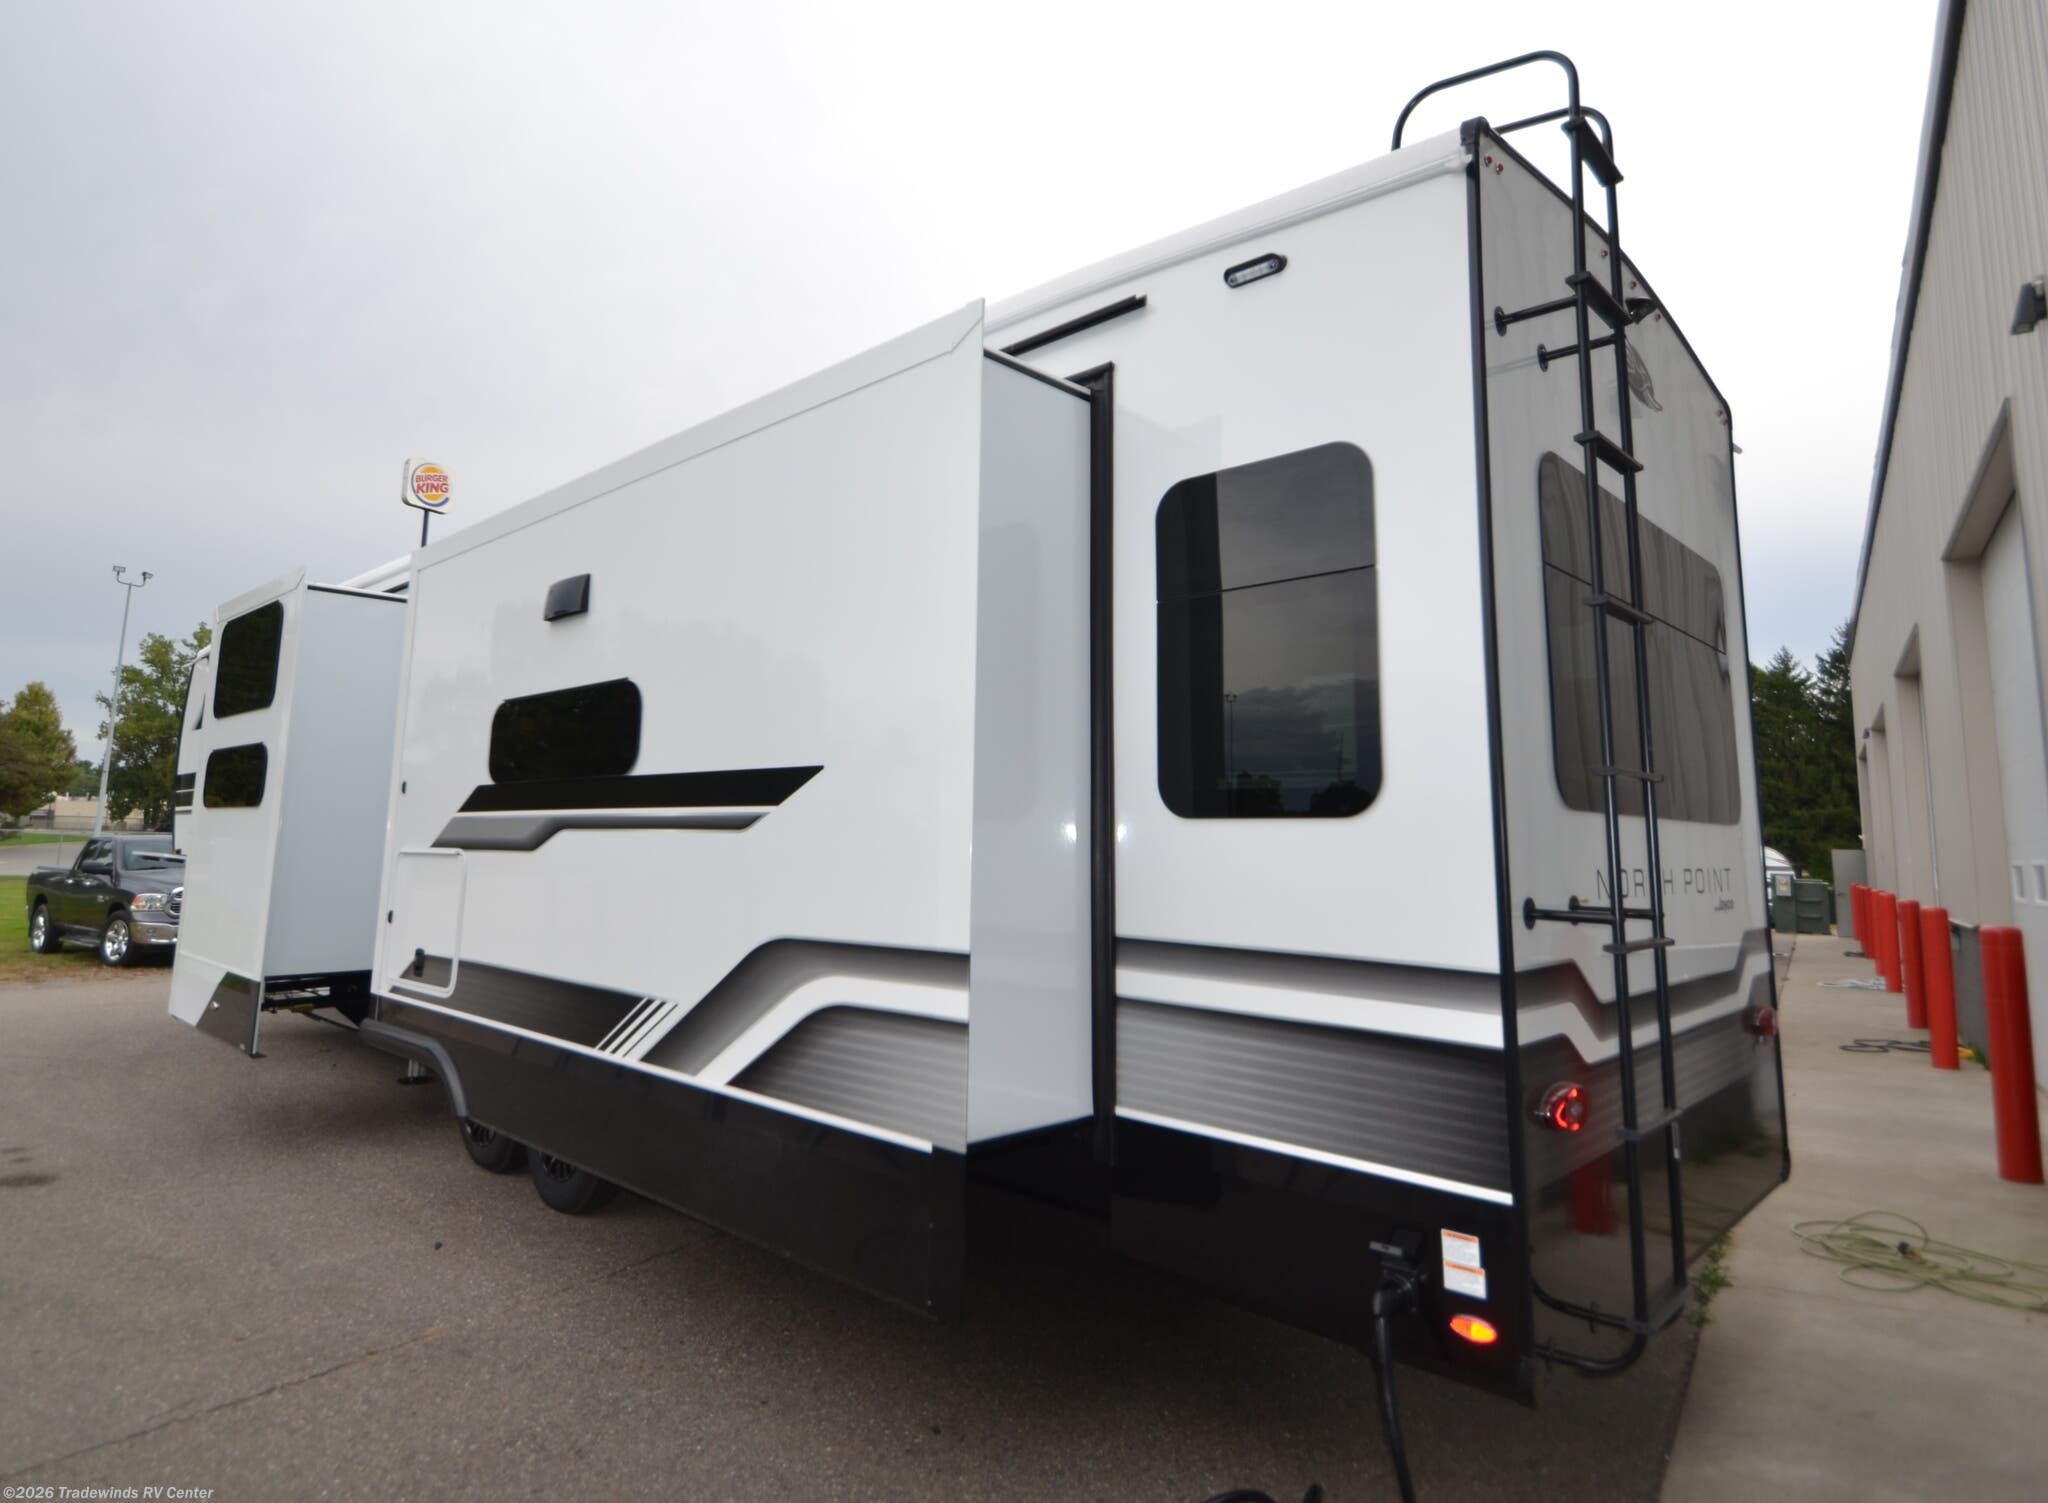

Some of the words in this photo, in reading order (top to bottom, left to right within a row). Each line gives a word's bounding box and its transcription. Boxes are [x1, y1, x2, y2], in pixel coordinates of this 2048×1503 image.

[416, 483, 448, 494] KING
[1596, 868, 1674, 900] NORH
[1683, 867, 1732, 894] POINT
